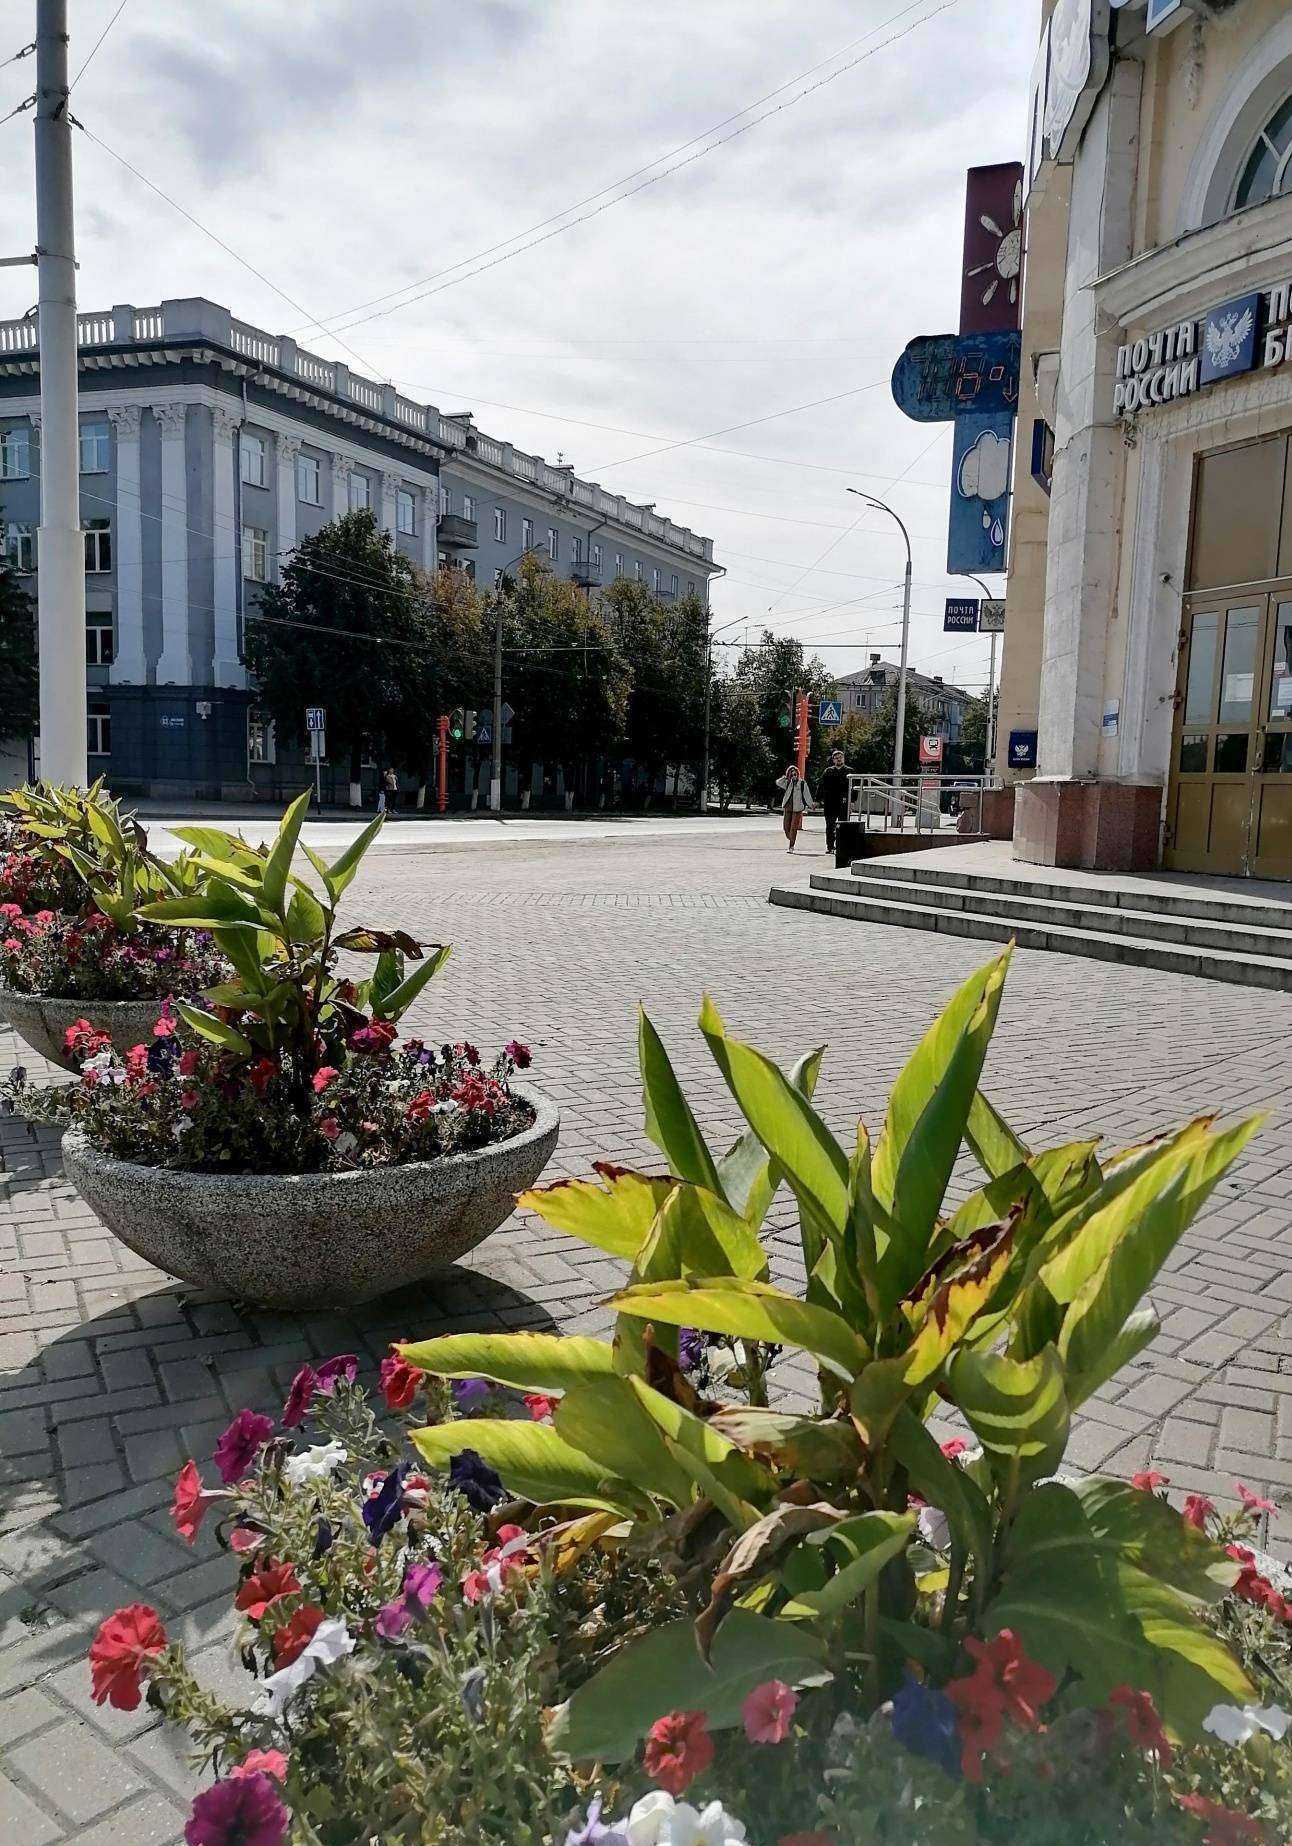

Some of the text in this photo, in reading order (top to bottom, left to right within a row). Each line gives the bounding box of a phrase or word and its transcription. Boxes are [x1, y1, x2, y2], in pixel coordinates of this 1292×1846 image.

[1267, 283, 1292, 324] П
[1115, 321, 1197, 378] ПОЧТА
[1112, 356, 1200, 416] РОССИИ
[947, 606, 974, 615] ПОЧТА
